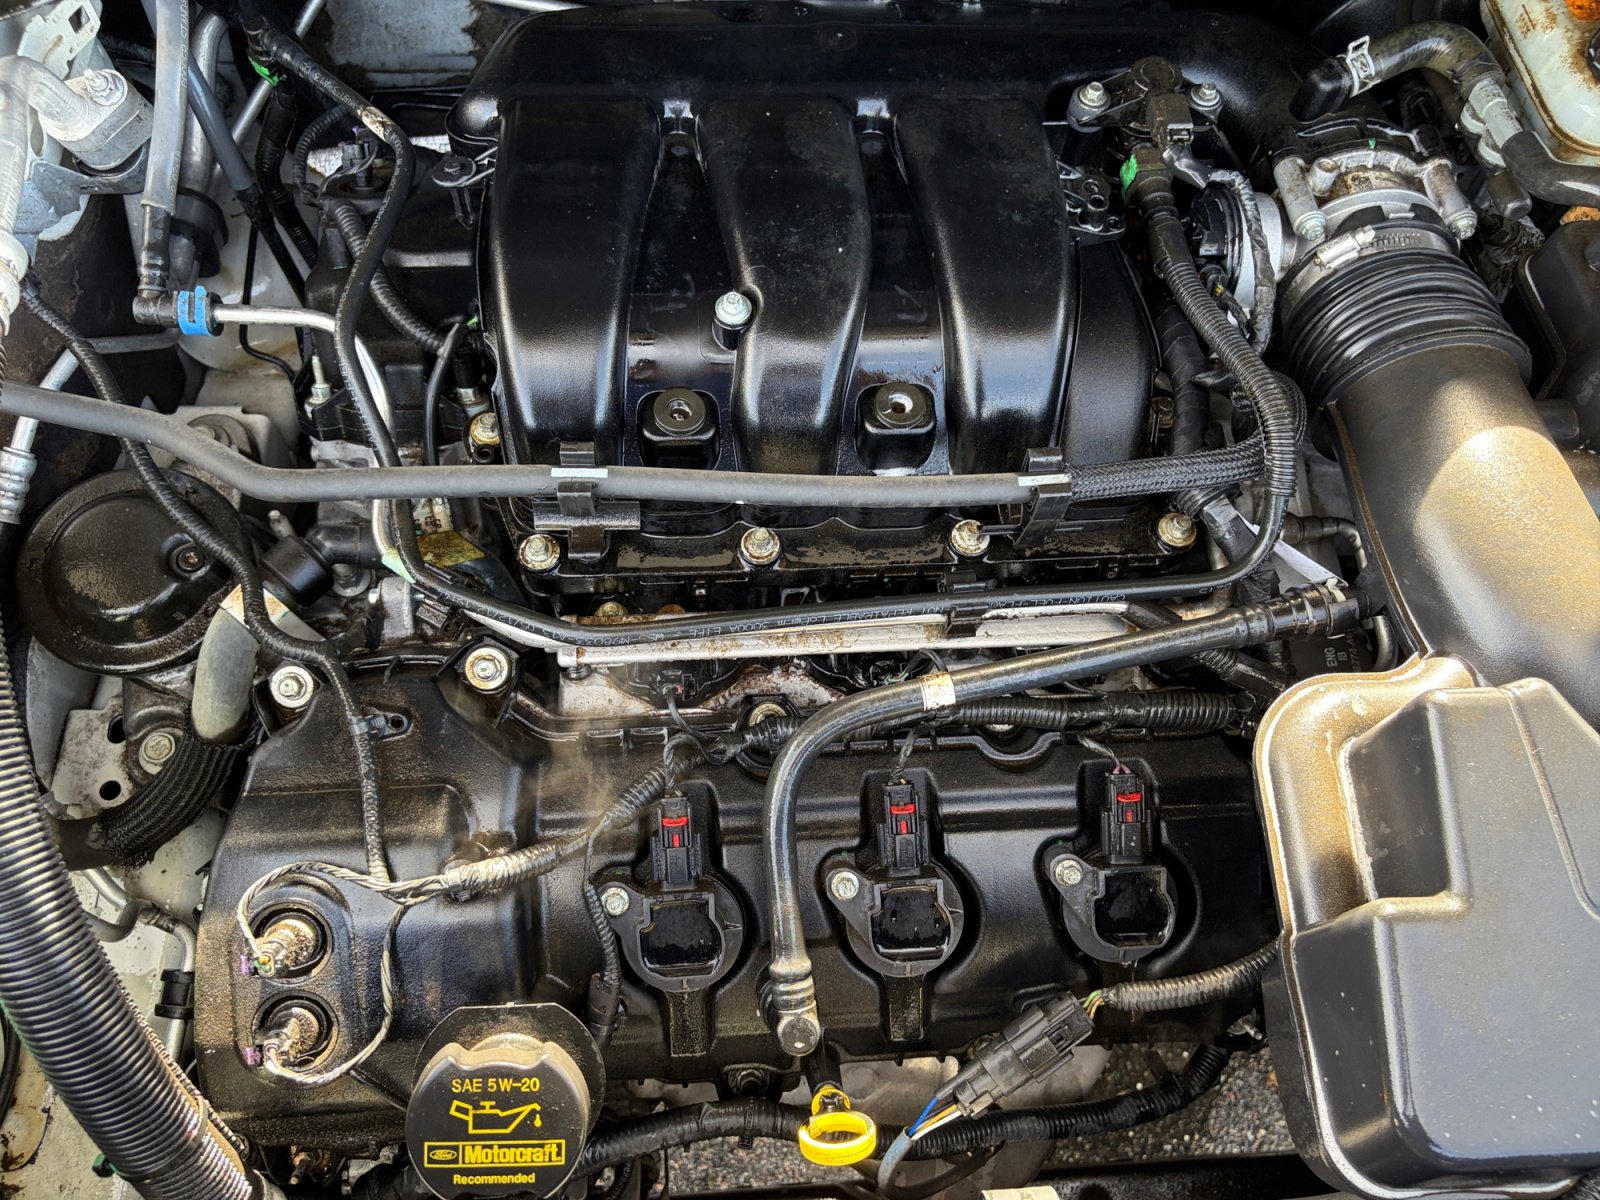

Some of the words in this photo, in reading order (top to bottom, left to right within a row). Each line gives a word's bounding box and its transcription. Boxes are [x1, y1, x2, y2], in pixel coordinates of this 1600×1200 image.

[777, 614, 826, 627] LoPerm
[833, 608, 913, 622] REPAIRABLE
[688, 625, 722, 638] ETFE
[729, 620, 769, 633] 3000A
[1324, 647, 1338, 667] ENG
[451, 1078, 482, 1093] SAE
[487, 1077, 540, 1092] 5W-20
[431, 1150, 457, 1160] Ford
[453, 1173, 536, 1185] Recommended
